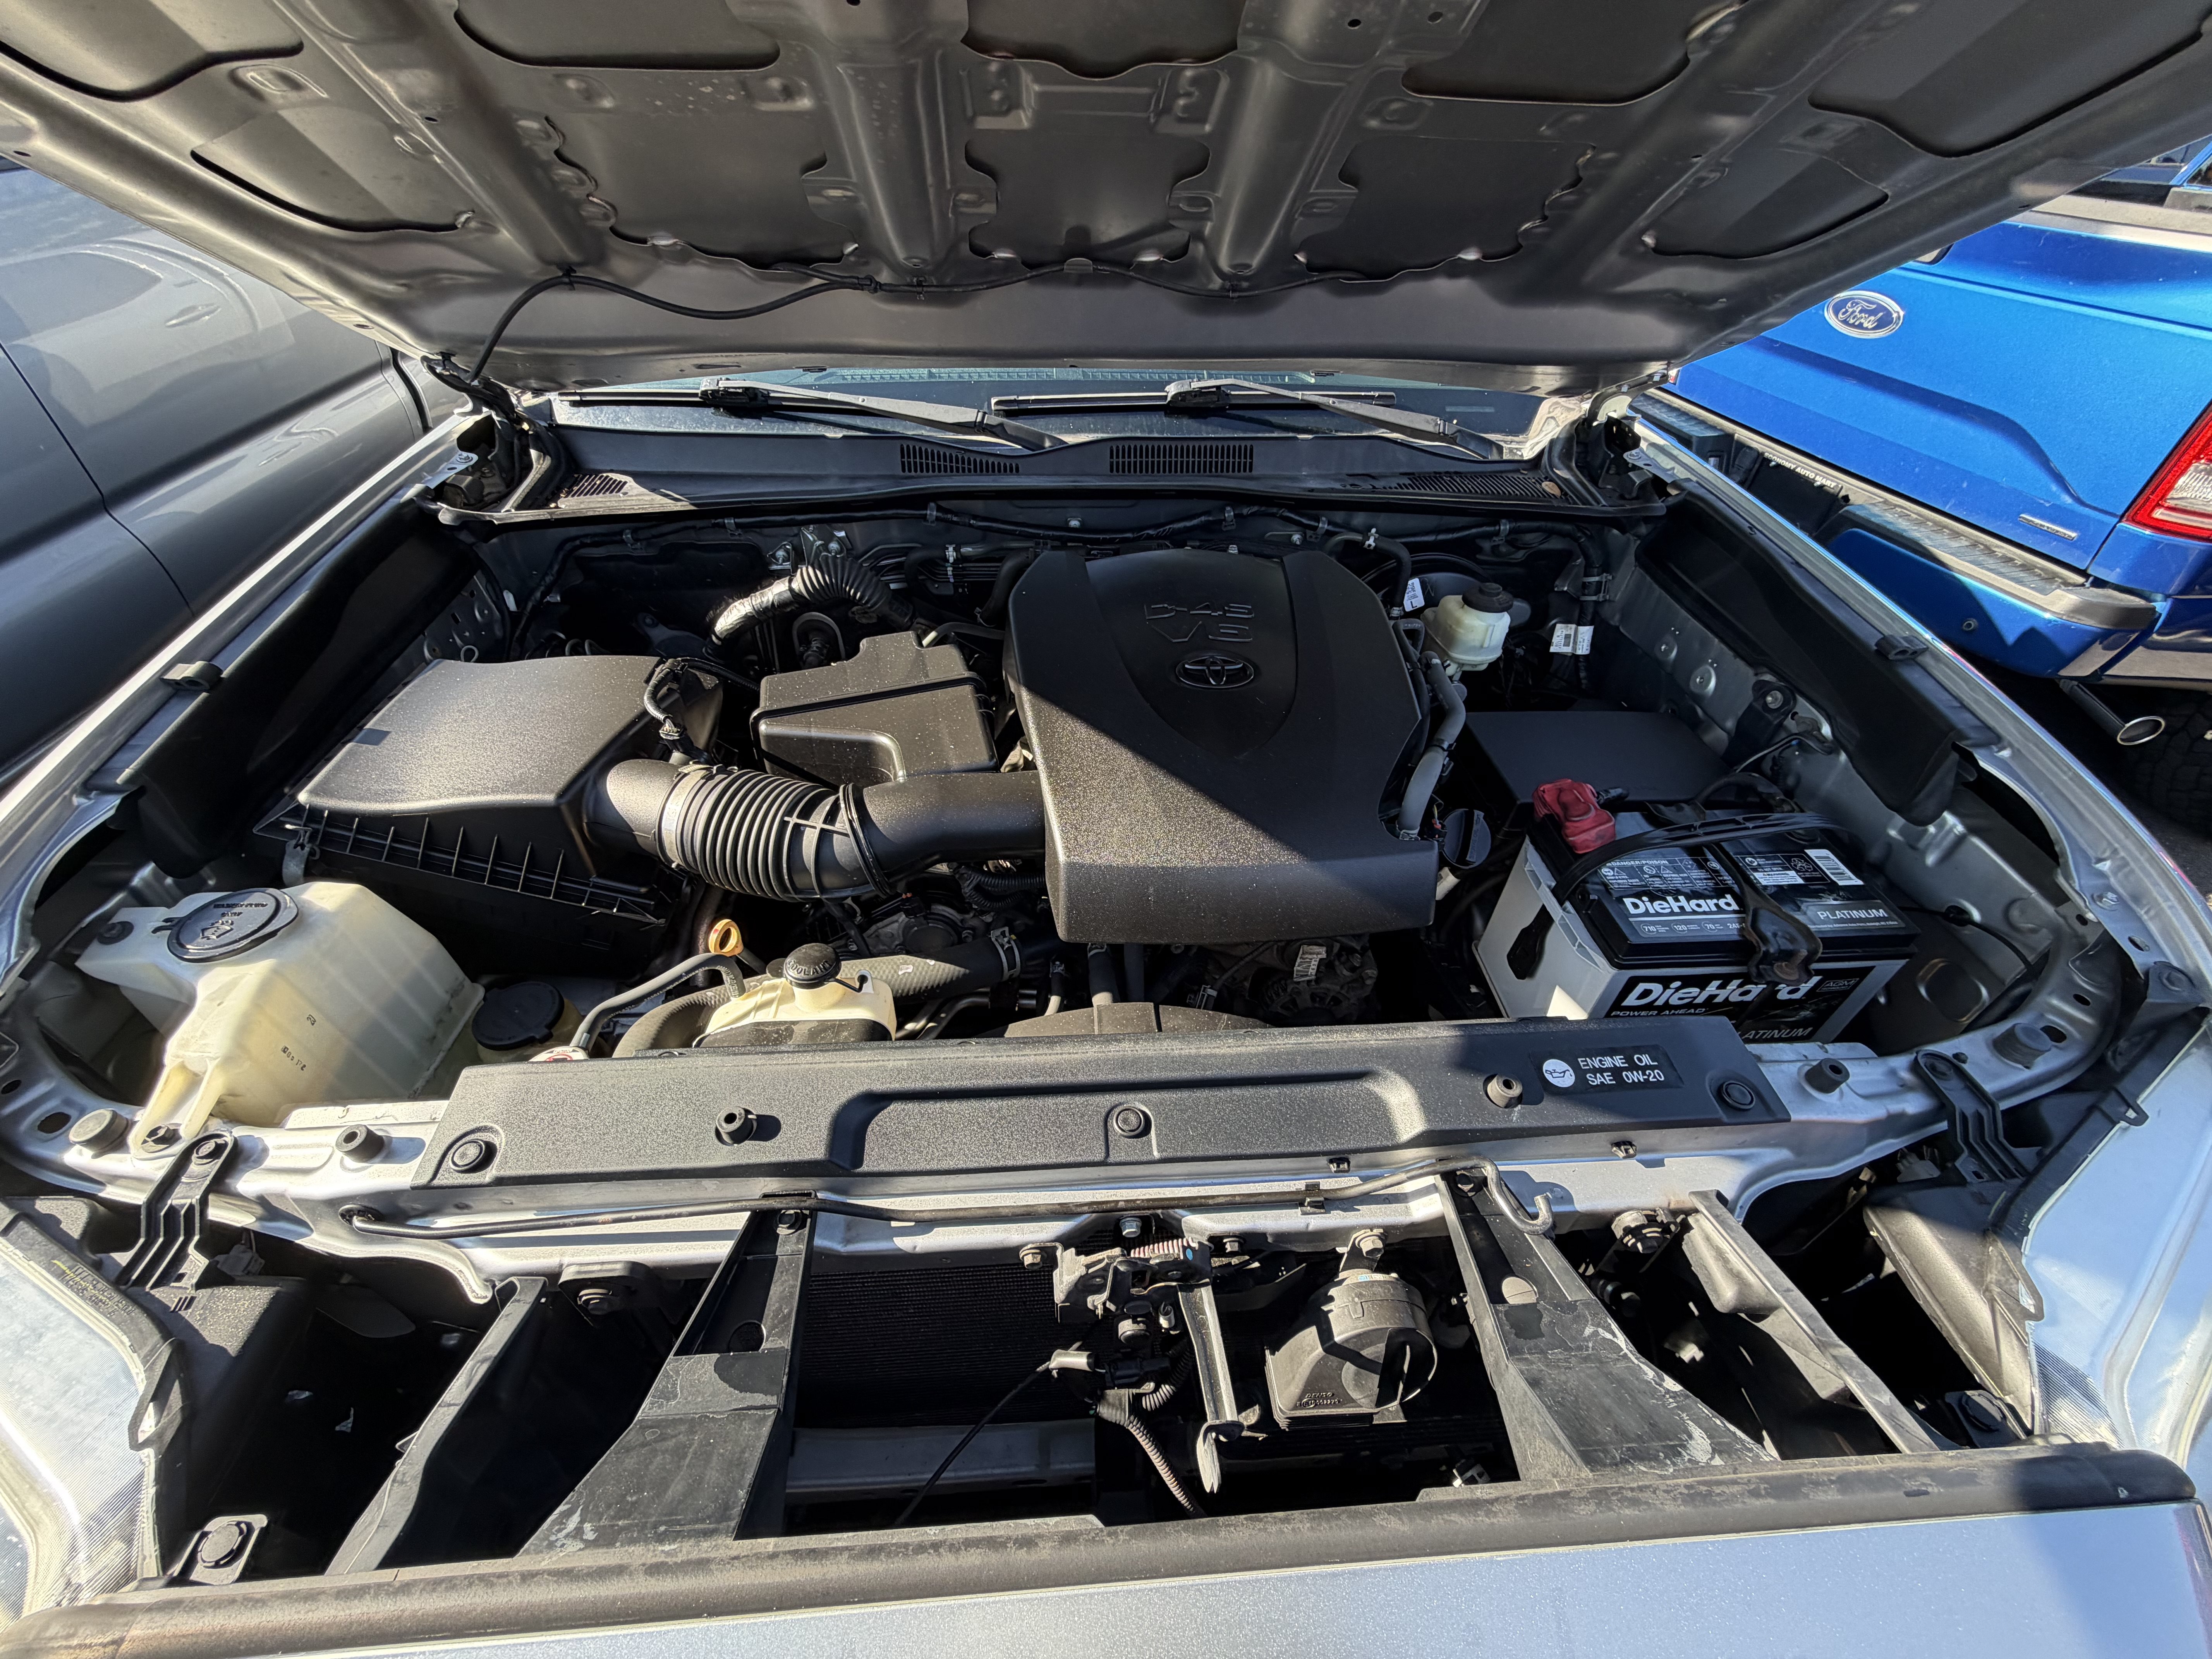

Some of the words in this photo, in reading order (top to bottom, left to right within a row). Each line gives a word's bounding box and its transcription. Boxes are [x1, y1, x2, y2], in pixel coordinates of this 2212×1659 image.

[1838, 299, 1886, 328] Ford
[1764, 452, 1796, 470] ECONOMY
[1795, 467, 1815, 479] AUTO
[1815, 475, 1837, 488] MART
[1147, 621, 1253, 642] V6
[1623, 895, 1740, 914] DieHard
[1817, 909, 1888, 920] PLATINUM
[788, 960, 833, 976] COOLANT
[1621, 975, 1822, 1006] DieHad
[1577, 1056, 1629, 1069] ENGINE
[1633, 1054, 1658, 1066] OIL
[1586, 1073, 1616, 1085] SAE
[1622, 1070, 1665, 1084] 0W-20
